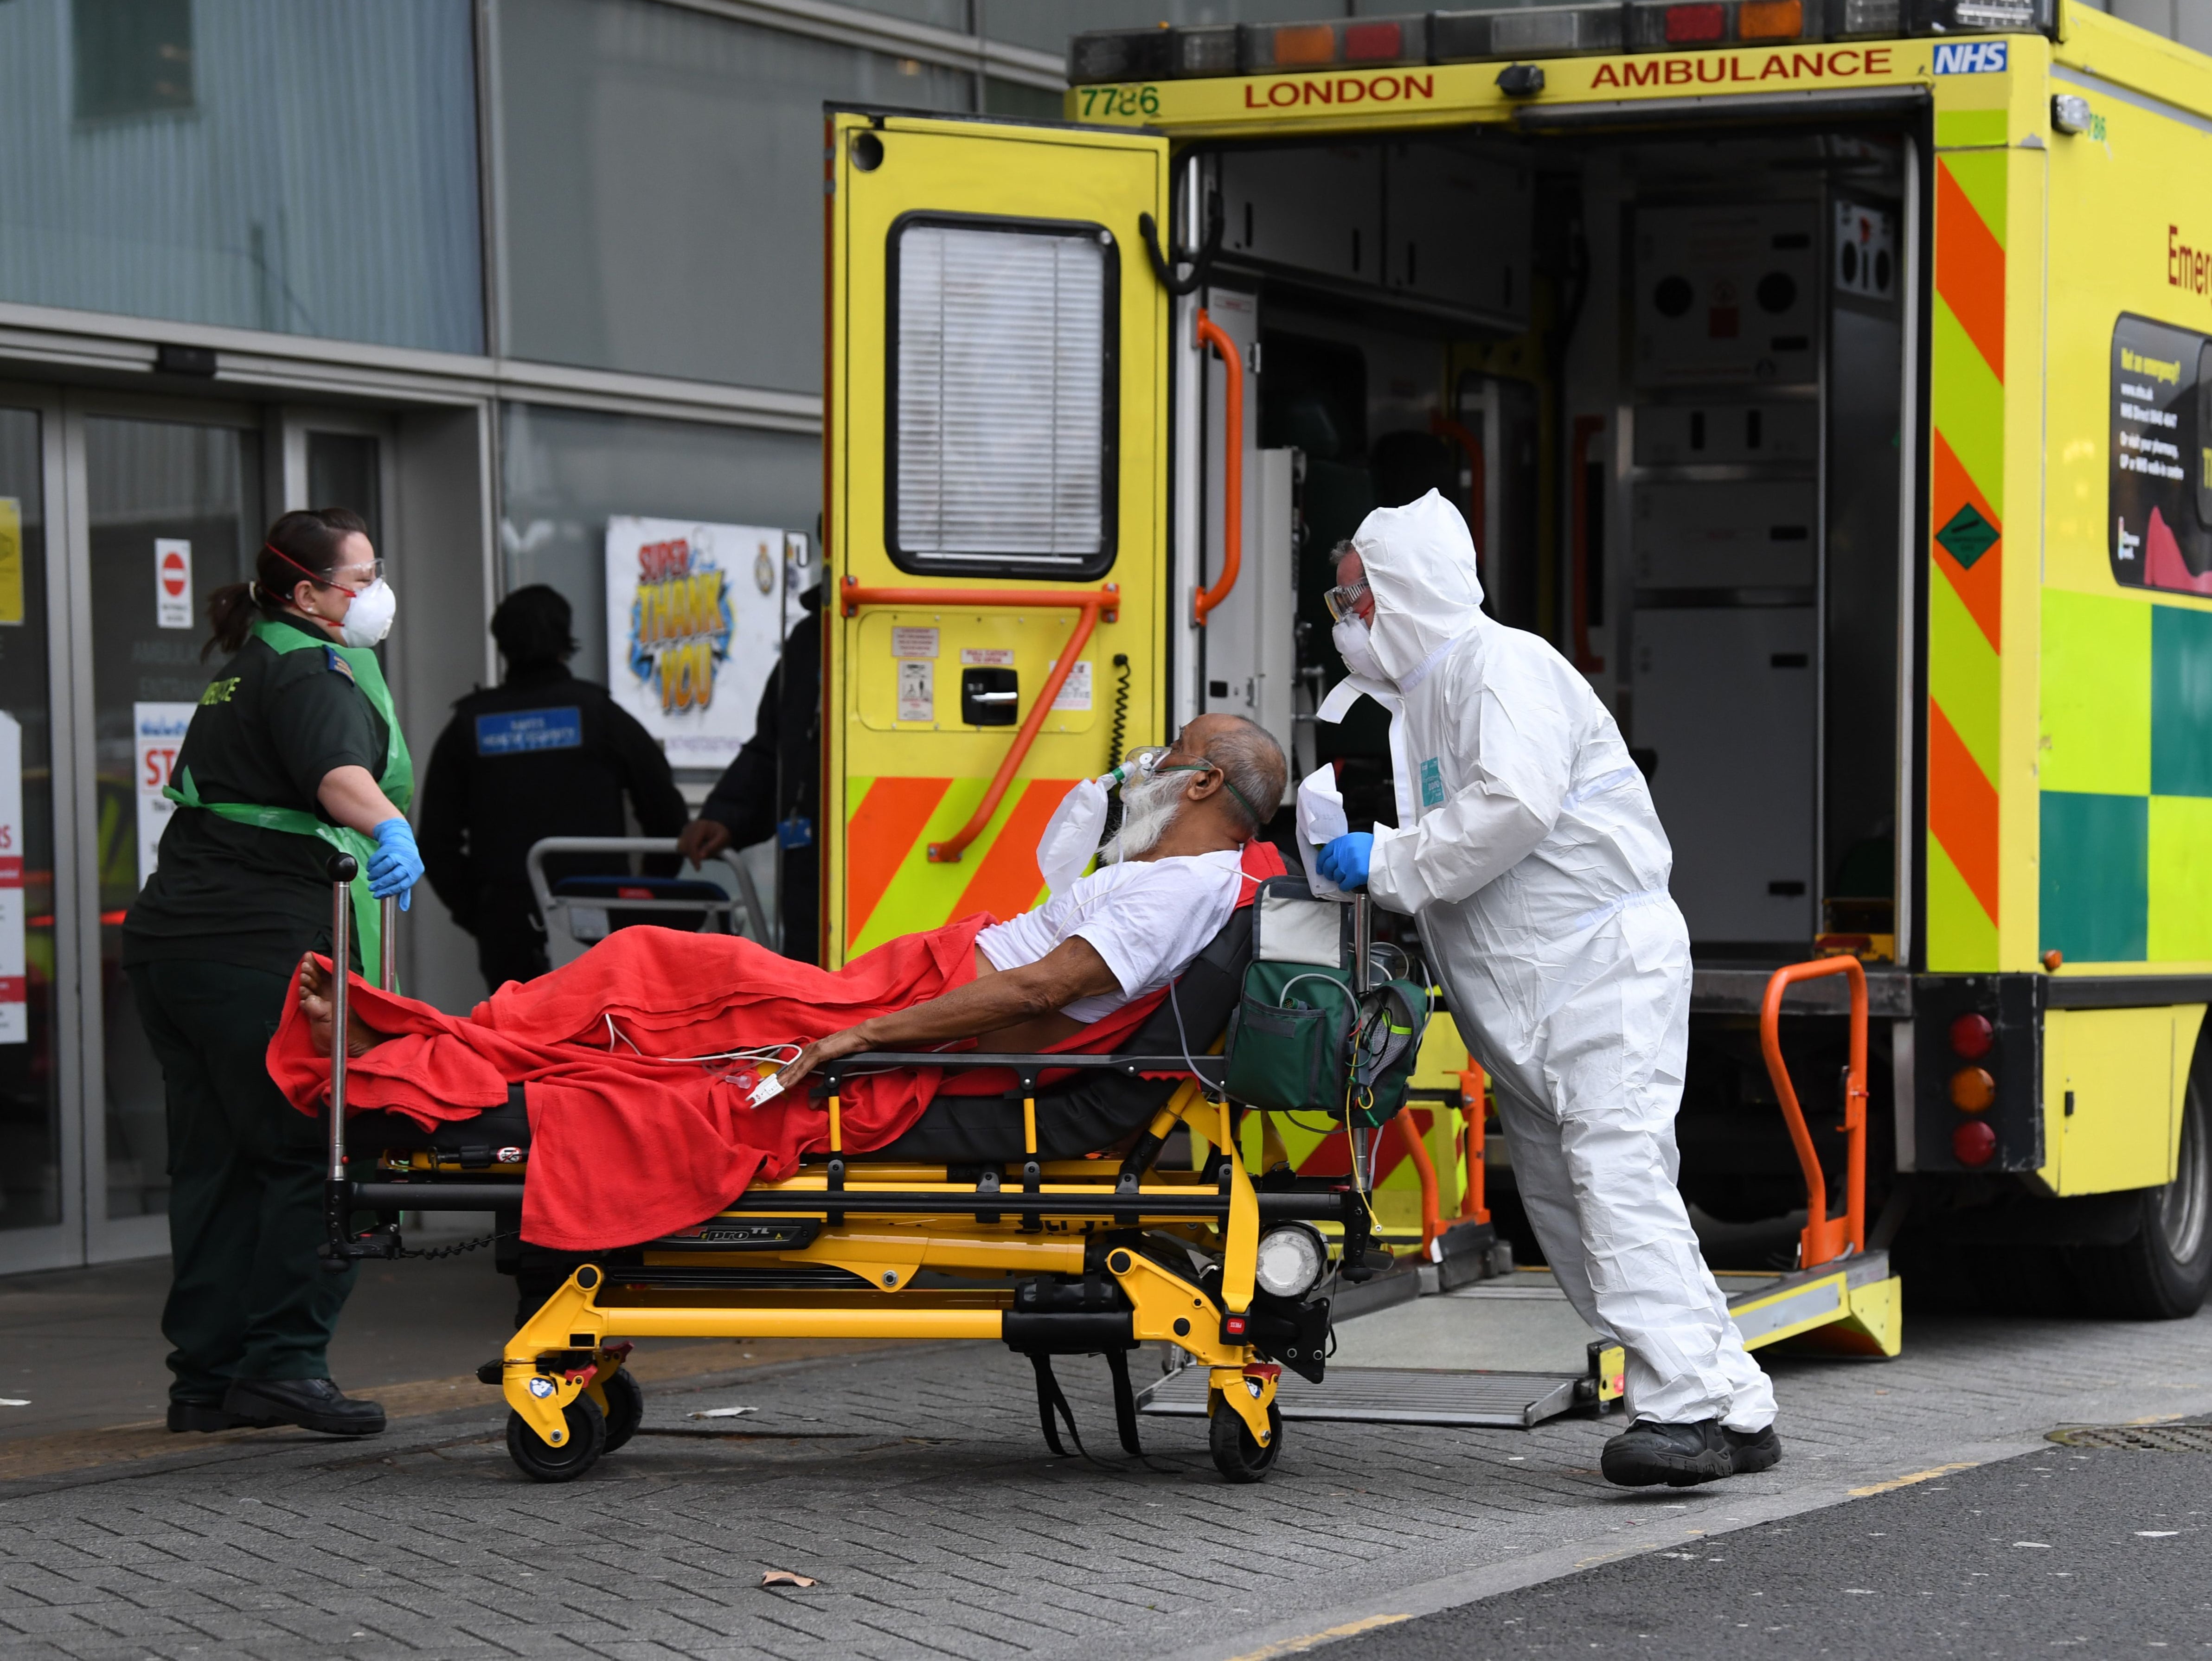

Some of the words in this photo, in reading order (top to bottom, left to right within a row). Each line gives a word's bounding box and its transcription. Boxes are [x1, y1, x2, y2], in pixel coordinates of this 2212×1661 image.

[1244, 74, 1433, 109] LONDON
[1590, 49, 1892, 89] AMBULANCE
[1935, 42, 2006, 74] NHS
[1081, 86, 1159, 116] 7786
[2169, 224, 2212, 304] Emer
[639, 539, 689, 581] SUPER
[636, 569, 725, 645] THANK
[660, 643, 712, 709] YOU
[145, 748, 175, 786] ST
[706, 1231, 750, 1242] pro
